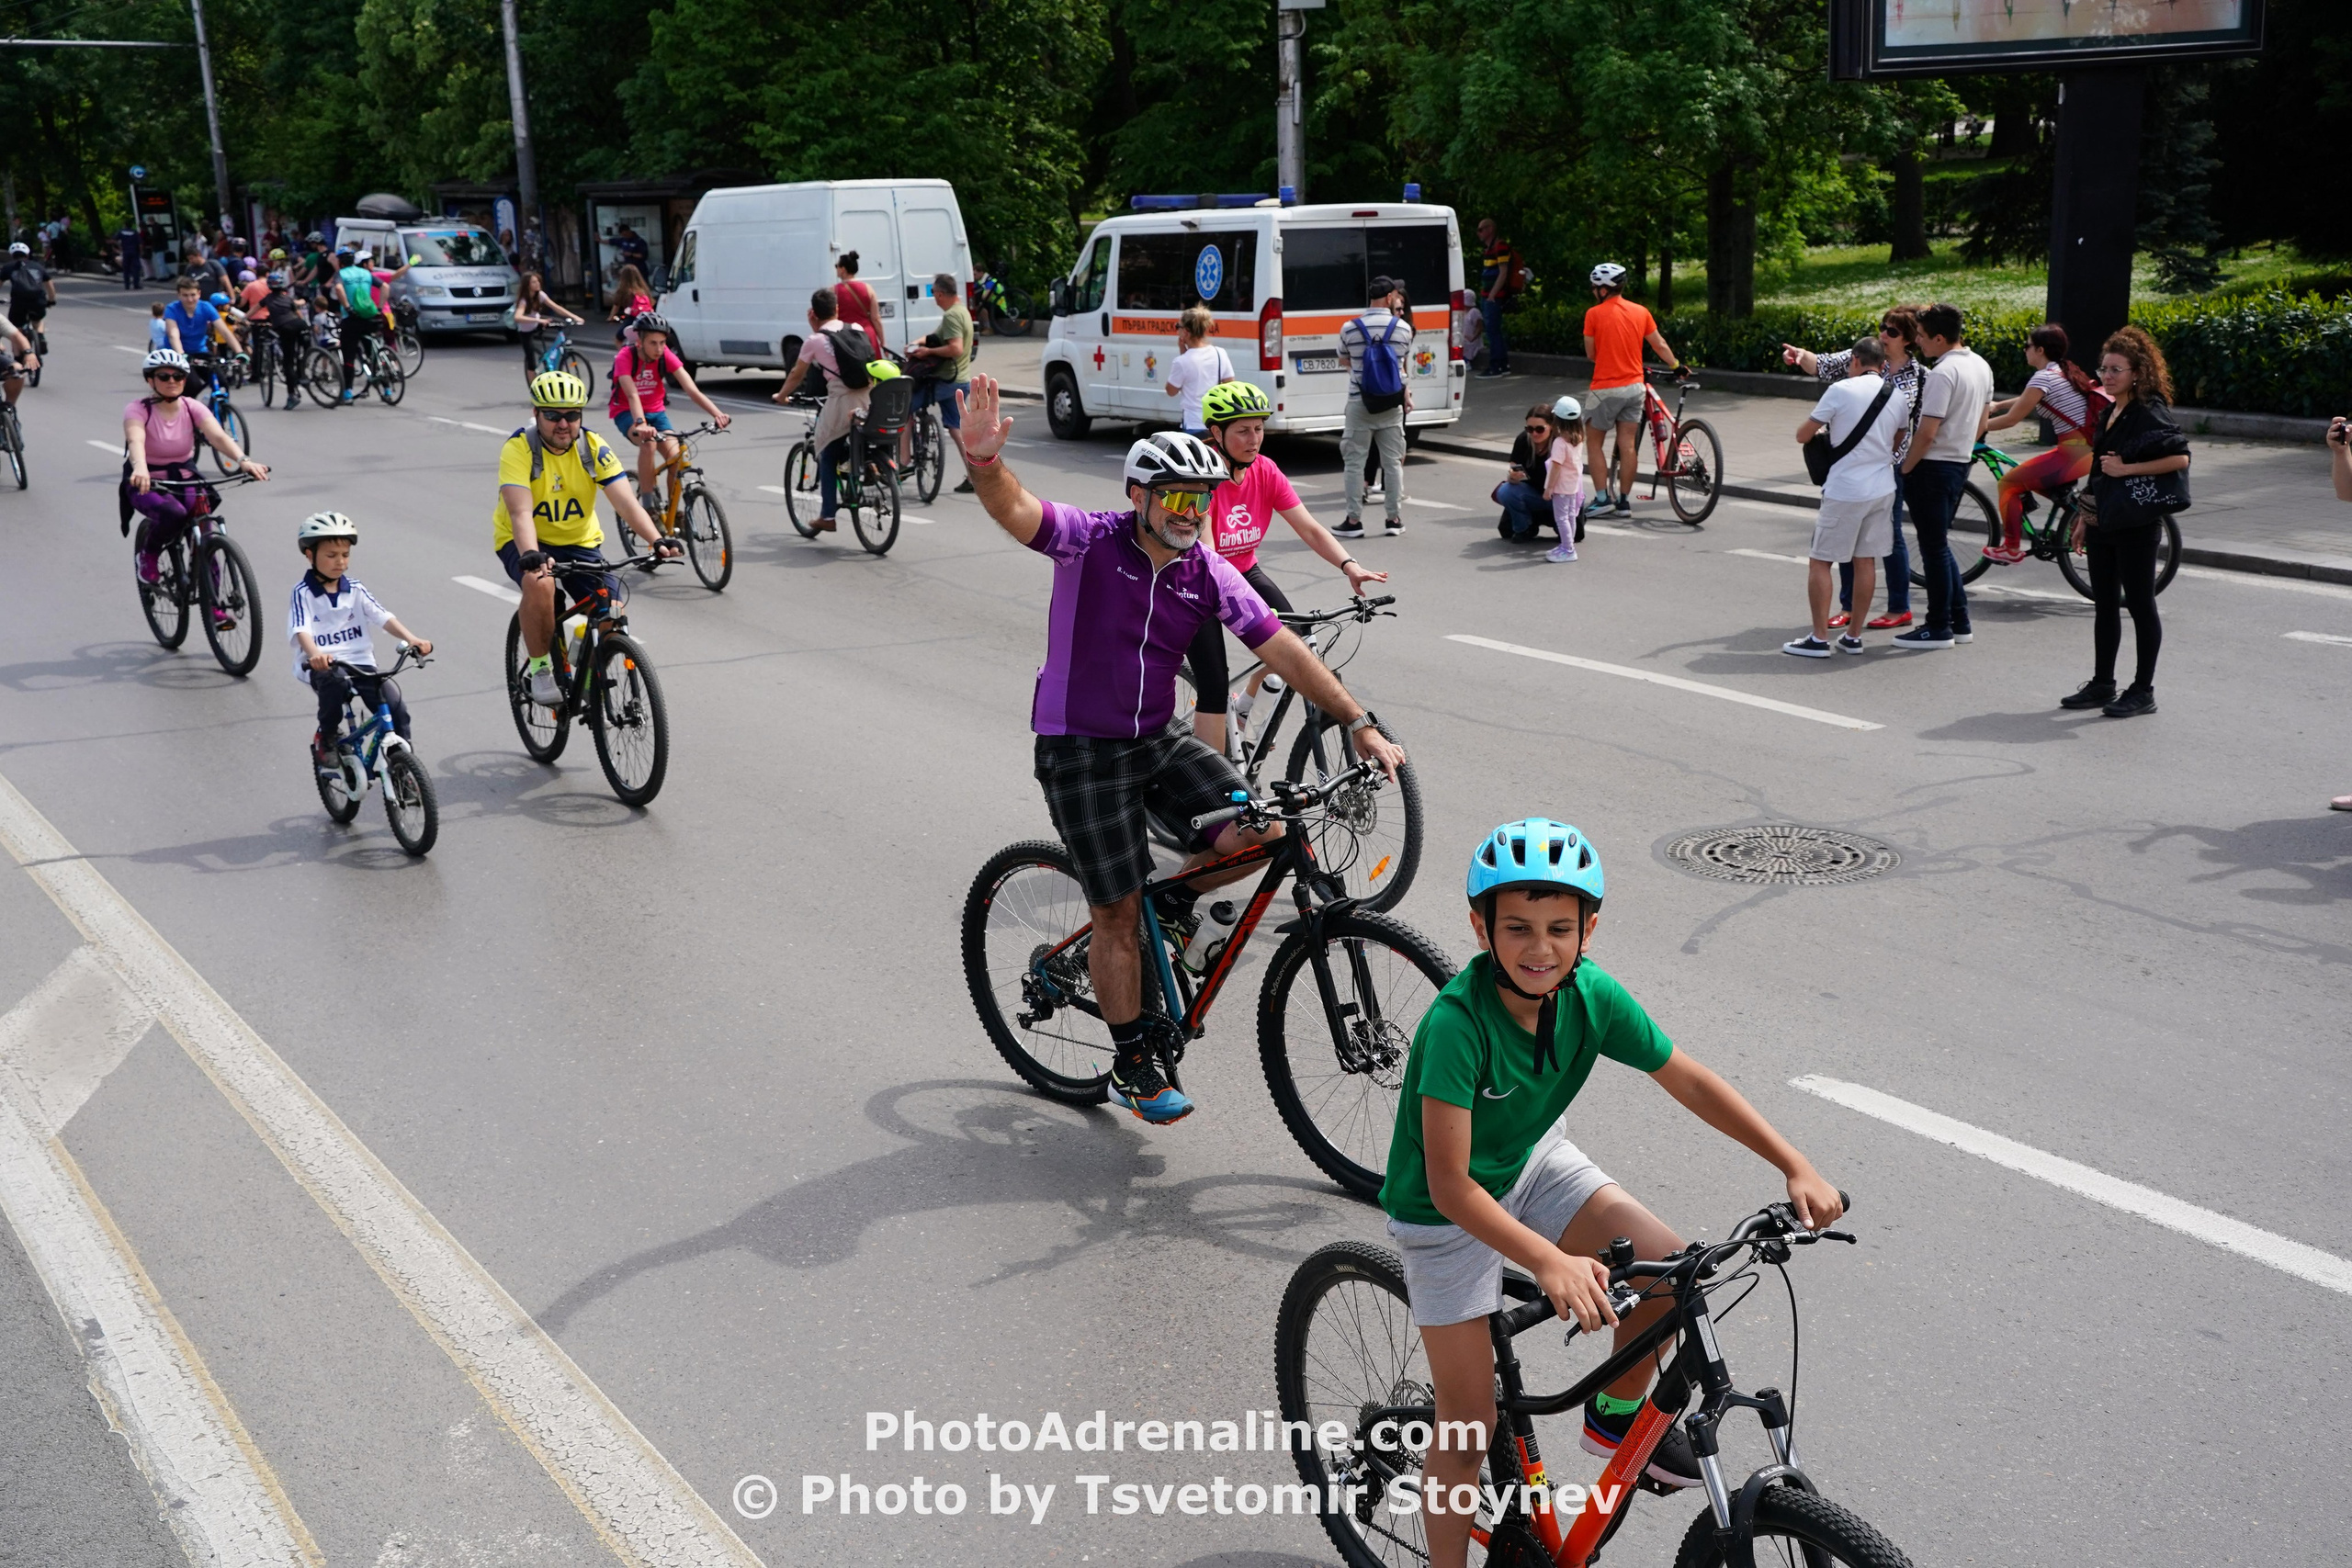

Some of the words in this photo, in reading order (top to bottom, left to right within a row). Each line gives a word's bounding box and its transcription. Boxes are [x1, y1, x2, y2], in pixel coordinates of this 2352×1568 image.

[1123, 320, 1146, 331] ПЪРВА
[1148, 321, 1178, 333] ГРАДСК
[1303, 360, 1314, 369] CB
[1315, 359, 1335, 369] 7820
[532, 498, 584, 523] AIA
[1610, 1405, 1657, 1475] PINNACLE
